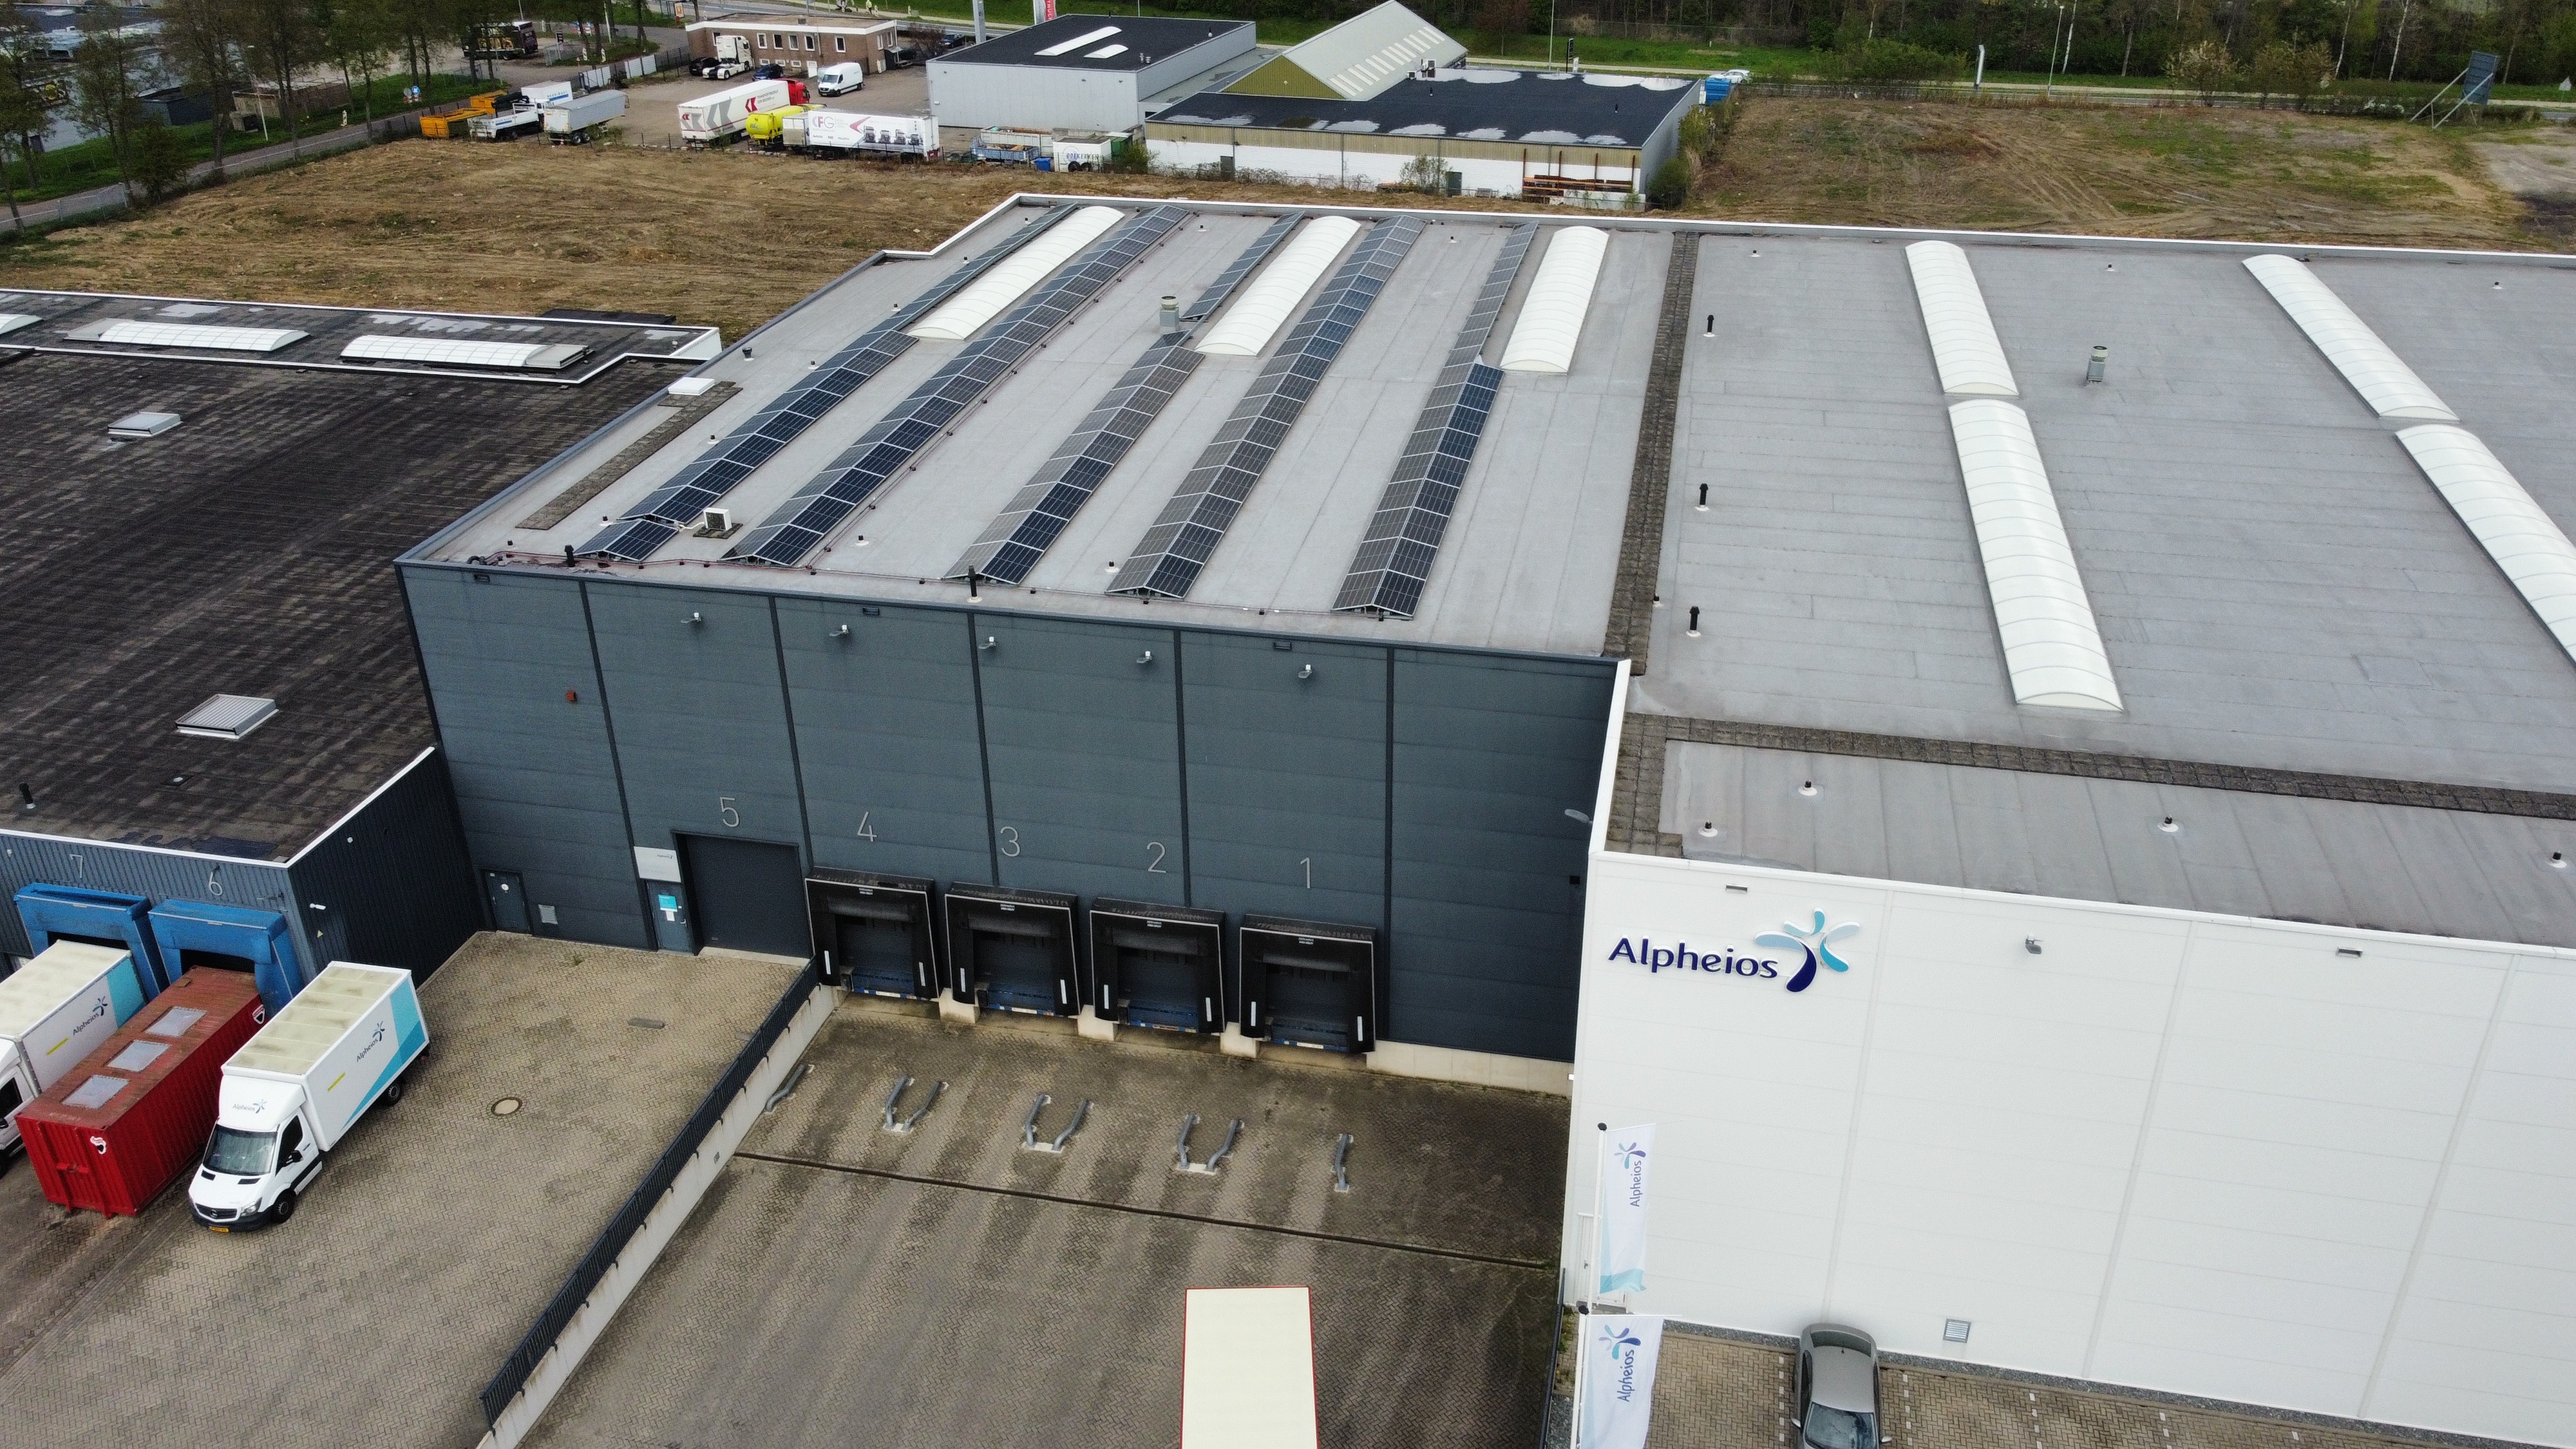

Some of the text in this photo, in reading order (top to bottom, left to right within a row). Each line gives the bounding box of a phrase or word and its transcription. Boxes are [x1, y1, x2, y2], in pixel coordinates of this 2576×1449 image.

[719, 796, 739, 828] 5
[857, 811, 878, 842] 4
[1000, 826, 1020, 857] 3
[1146, 841, 1167, 873] 2
[69, 853, 83, 878] 7
[1300, 857, 1311, 889] 1
[208, 871, 223, 896] 6
[1607, 934, 1778, 979] Alpheios
[72, 1012, 100, 1036] Alpheios
[356, 1037, 379, 1063] Alpheios
[1629, 1159, 1643, 1208] Alpheios
[1616, 1349, 1636, 1403] Alpheios
